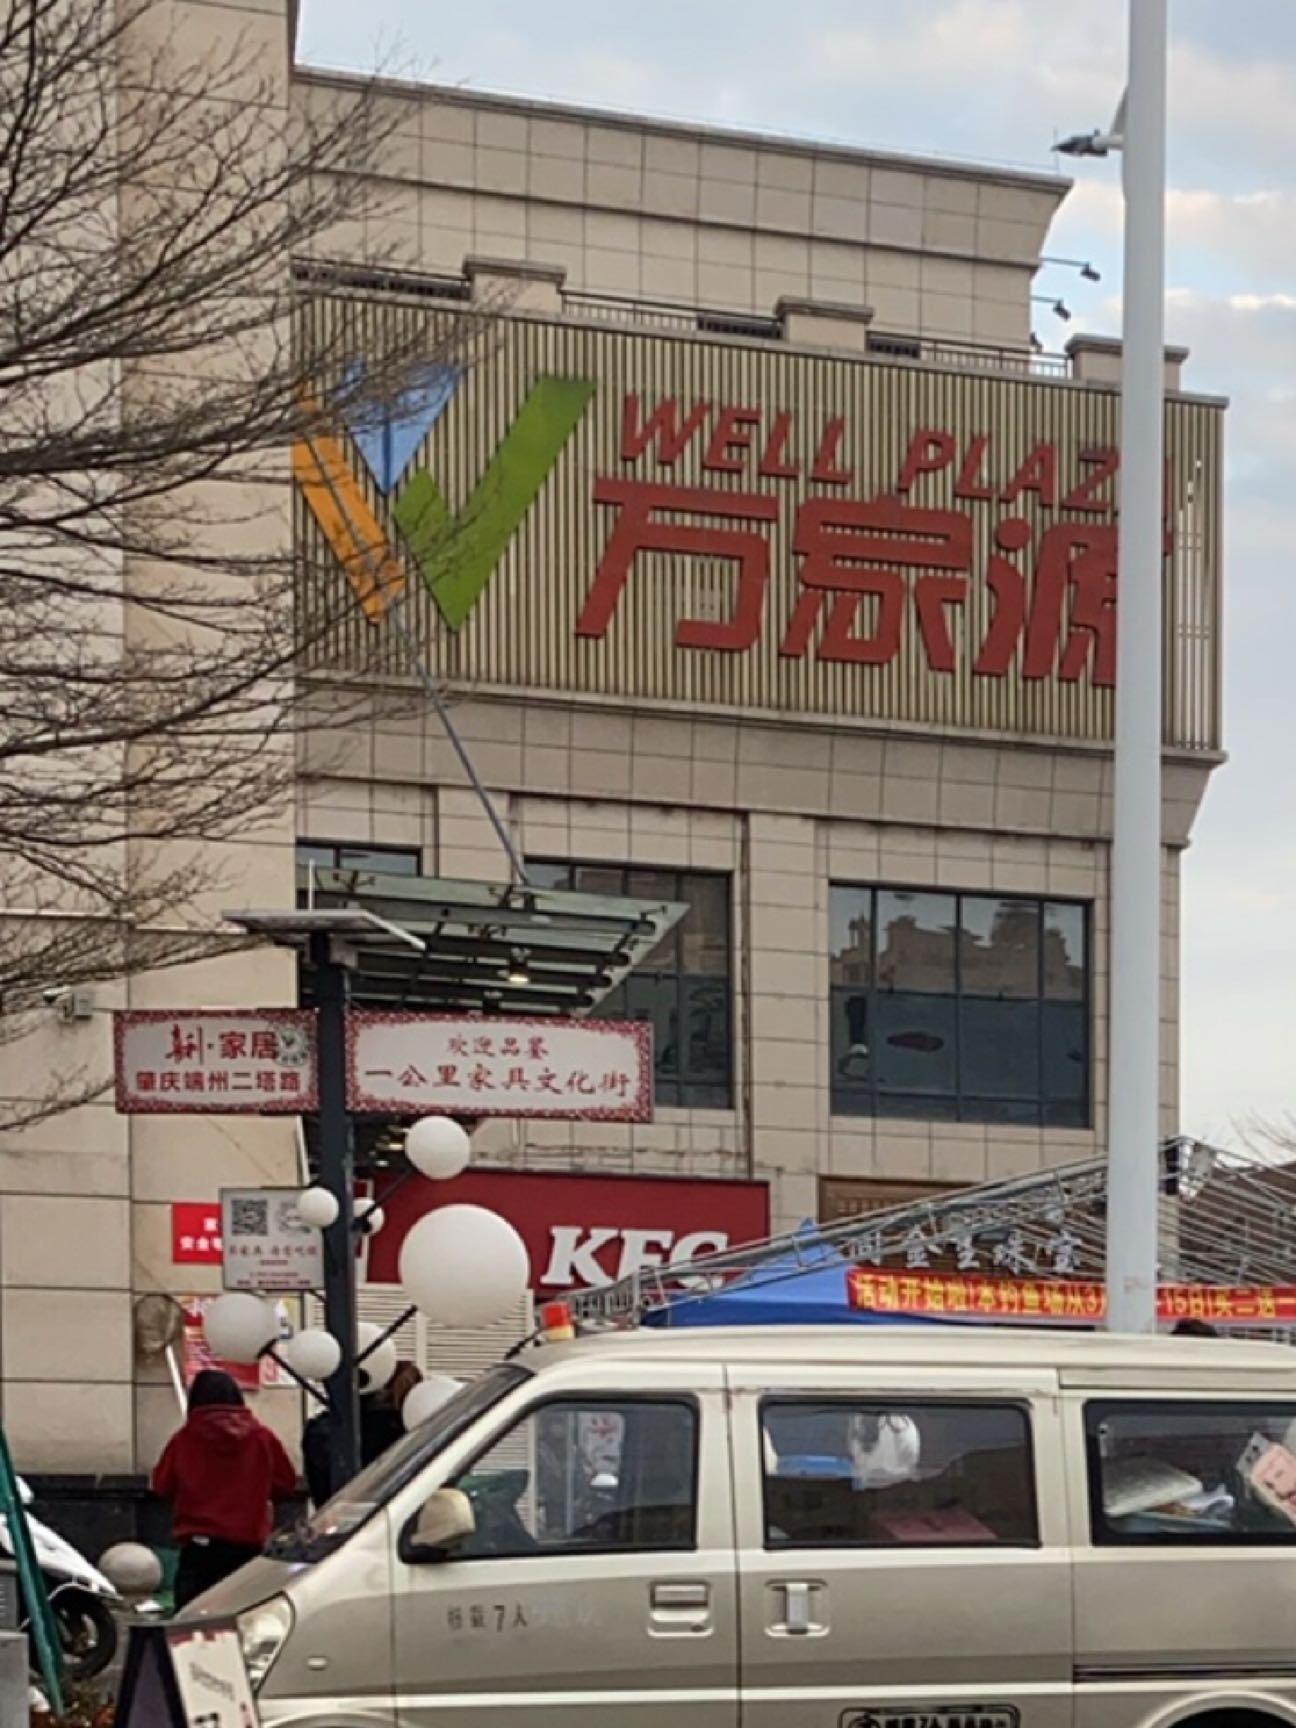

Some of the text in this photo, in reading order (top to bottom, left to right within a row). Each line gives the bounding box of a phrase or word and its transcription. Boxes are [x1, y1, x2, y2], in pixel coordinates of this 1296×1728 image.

[620, 391, 1174, 521] WELL PLAZ
[136, 1071, 301, 1092] 肇庆端州二塔路
[364, 1063, 631, 1097] 一公里家具文化街
[540, 1225, 729, 1292] KFC
